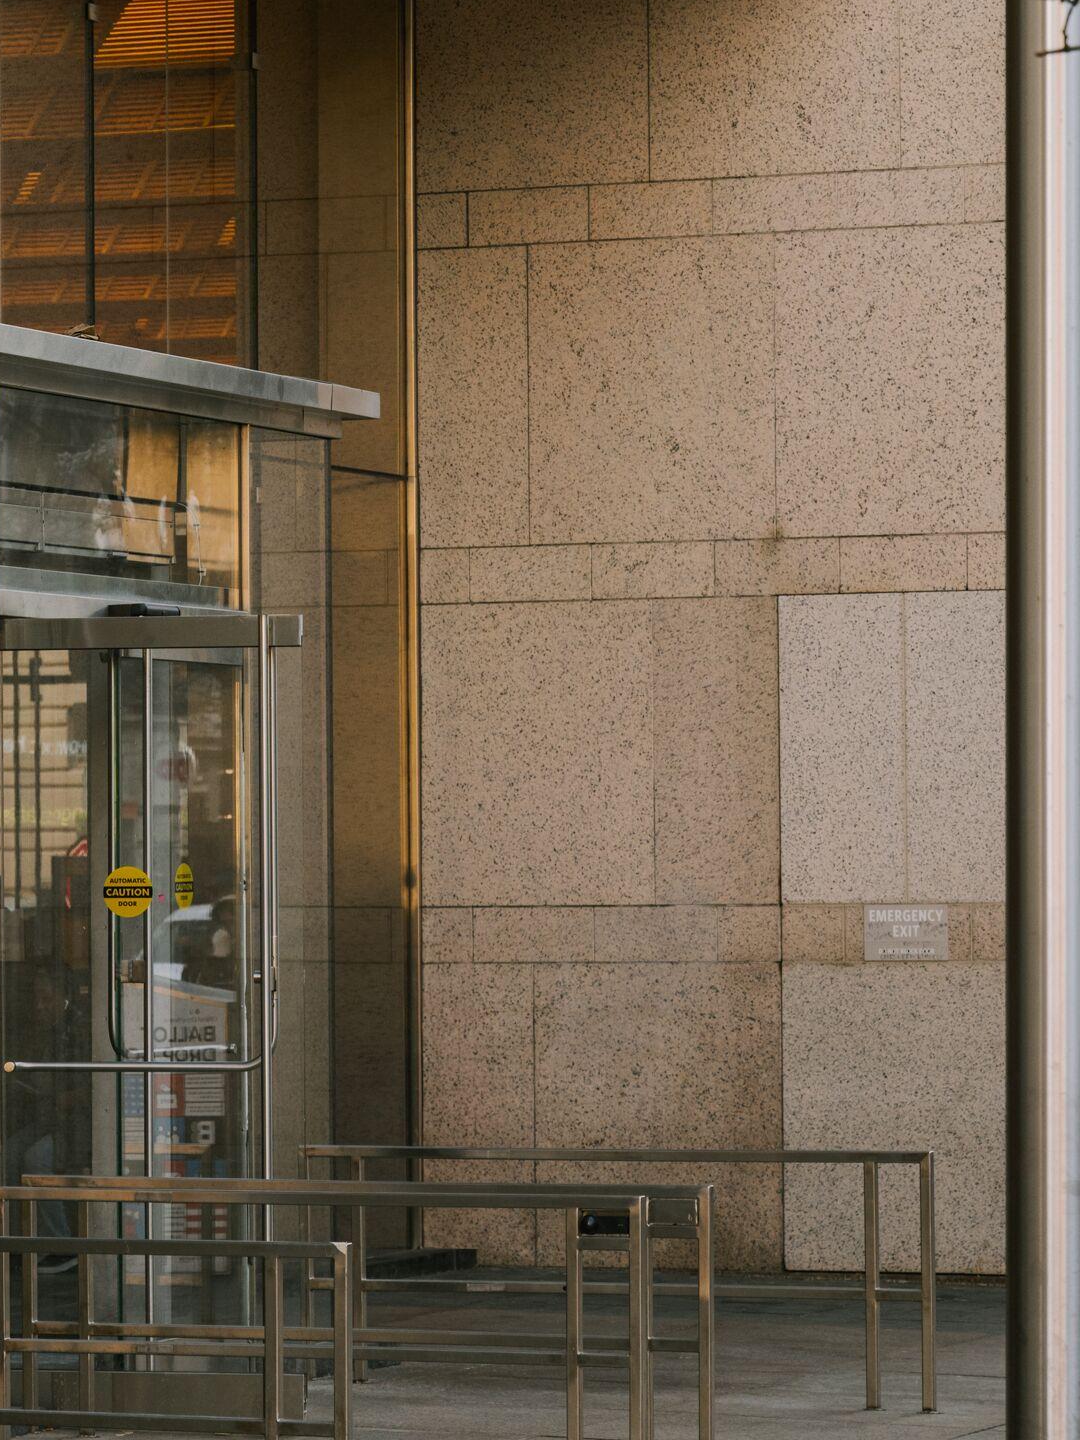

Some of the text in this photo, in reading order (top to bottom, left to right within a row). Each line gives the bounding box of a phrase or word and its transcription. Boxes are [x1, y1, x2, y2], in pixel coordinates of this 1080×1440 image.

[106, 888, 150, 897] CAUTION
[869, 909, 943, 922] EMERGENCY
[892, 924, 921, 938] EXIT
